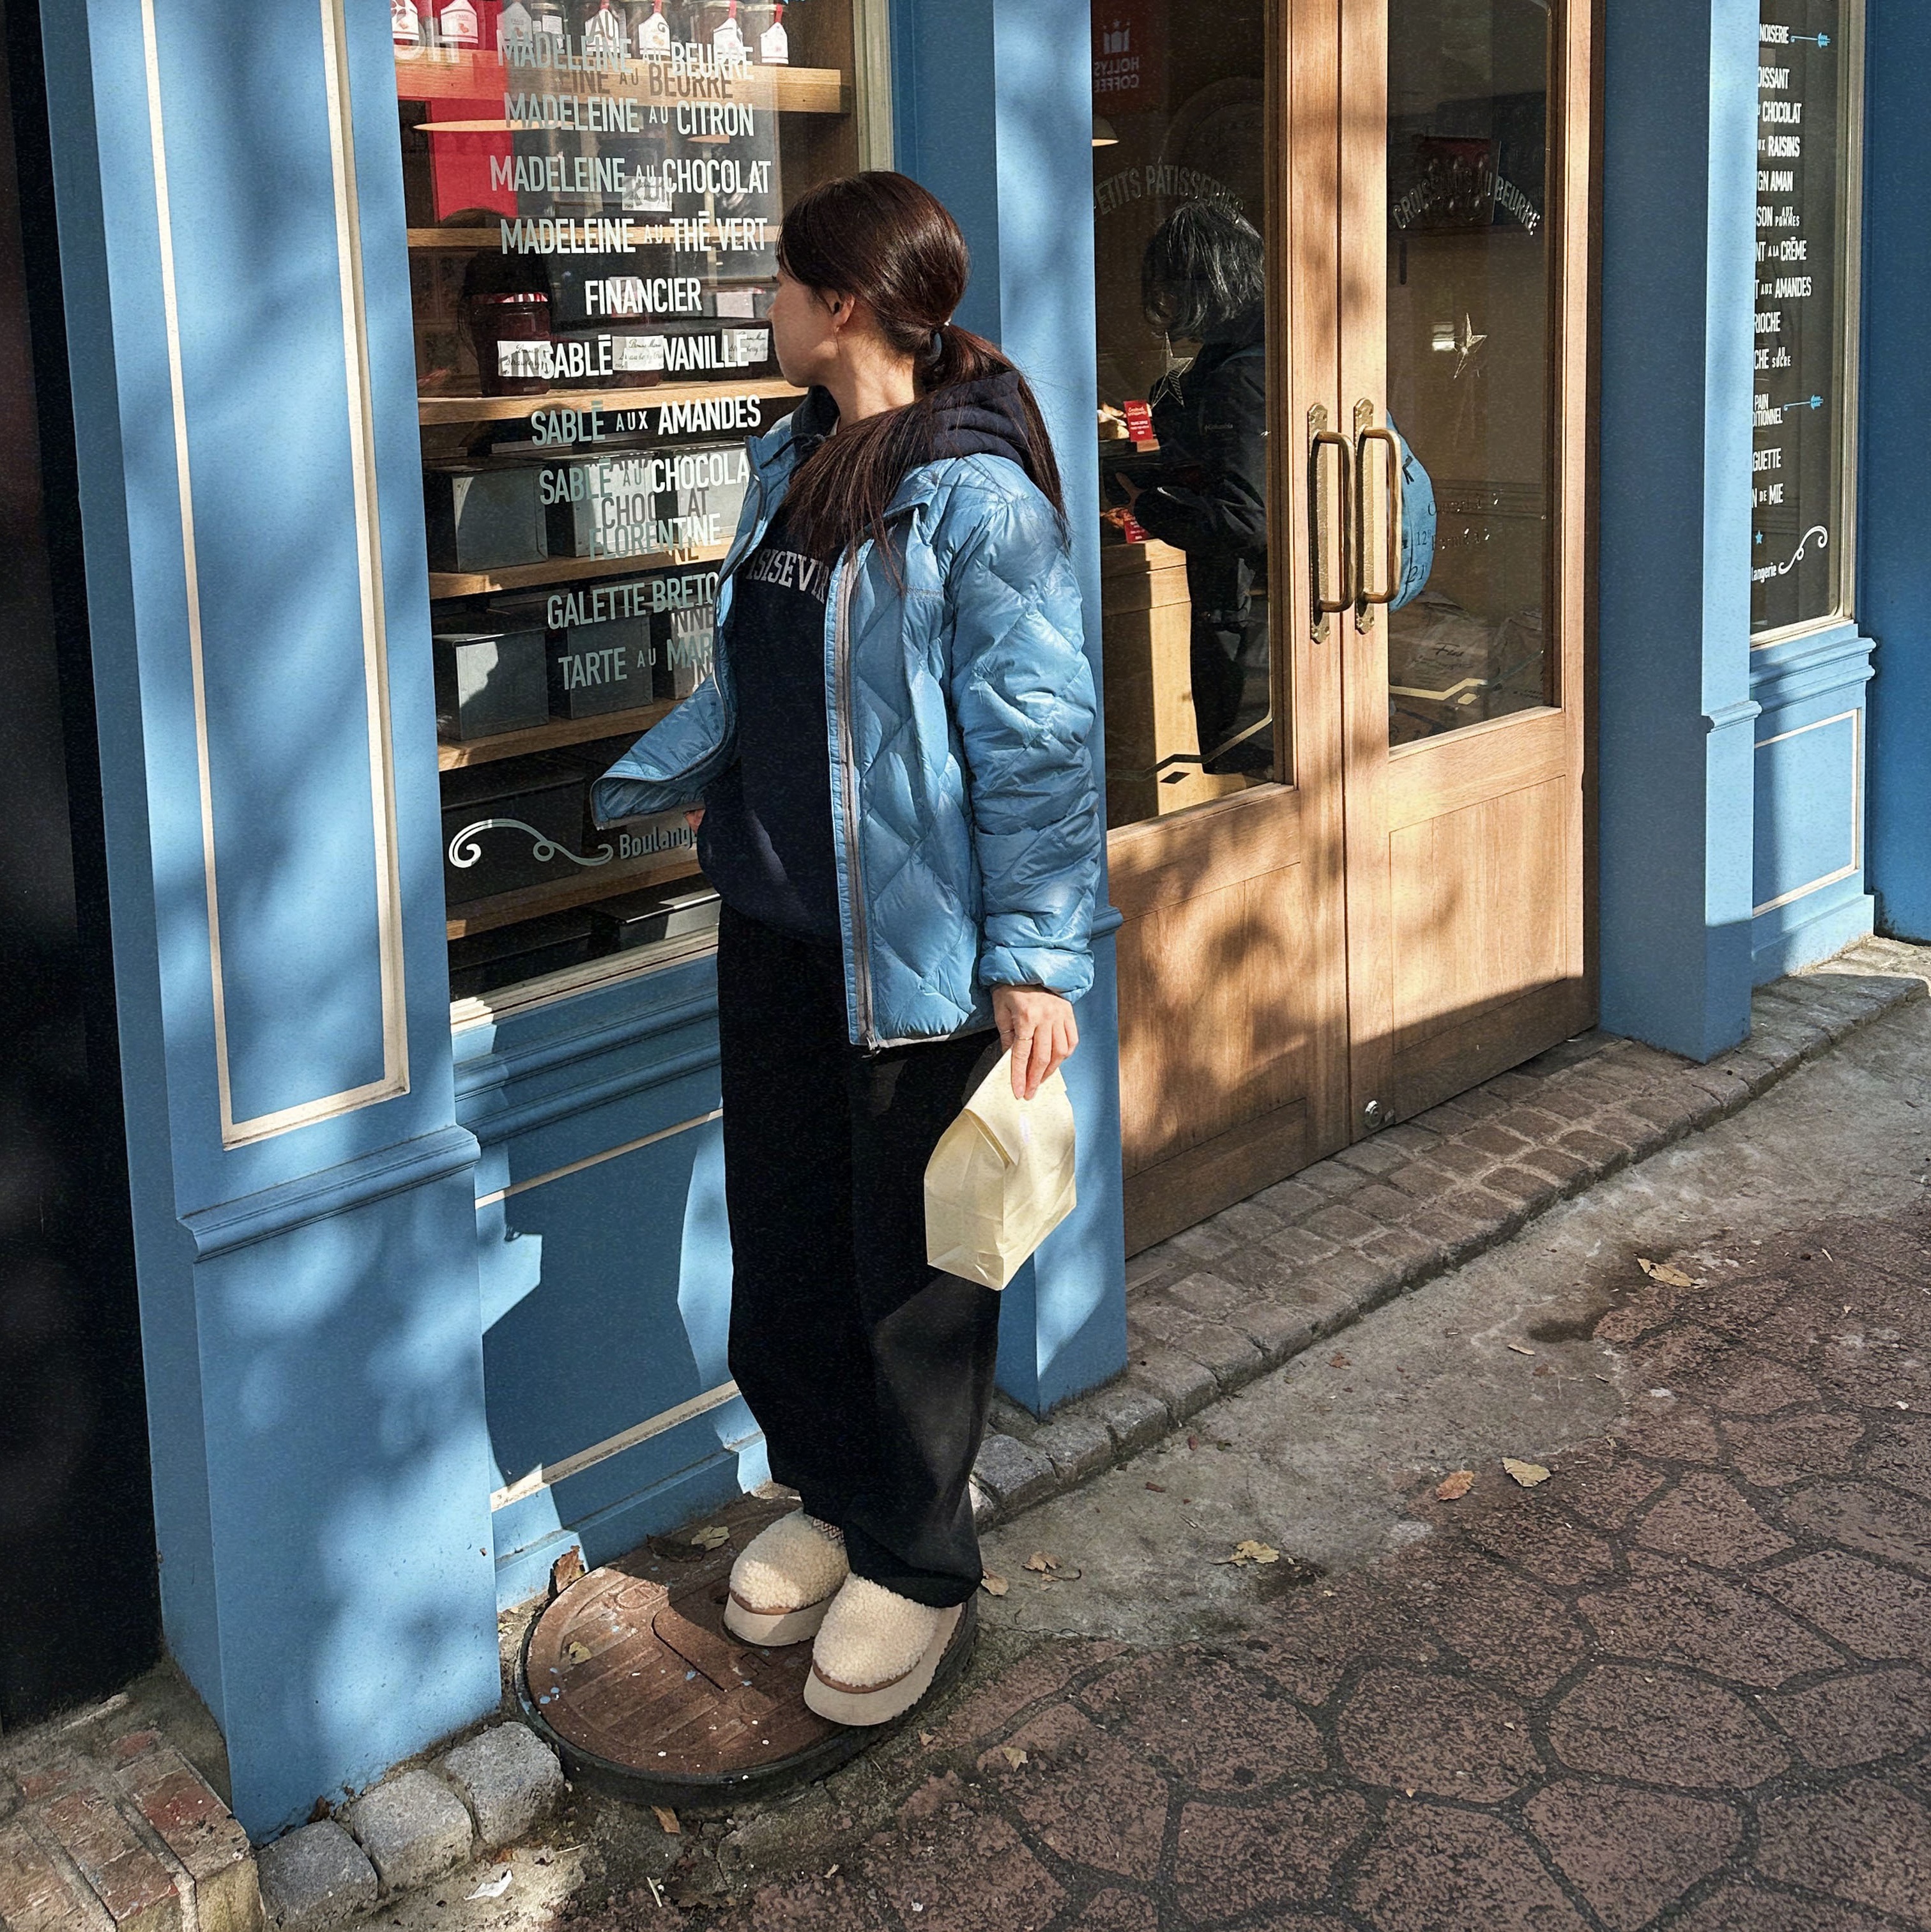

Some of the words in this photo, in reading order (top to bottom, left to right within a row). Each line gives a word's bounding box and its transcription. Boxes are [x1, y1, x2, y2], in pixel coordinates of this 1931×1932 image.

[1759, 24, 1789, 44] NOISERIE
[497, 29, 632, 73] MADELEINE
[643, 47, 662, 64] AU
[671, 42, 754, 80] BEURRE
[504, 93, 639, 133] MADELEINE
[649, 105, 668, 124] AU
[676, 100, 754, 137] CITRON
[1763, 101, 1802, 123] CHOCOLAT
[1768, 135, 1800, 157] RAISINS
[489, 155, 627, 192] MADELEINE
[635, 164, 655, 183] AU
[662, 158, 771, 194] CHOCOLAT
[1757, 170, 1769, 192] GN
[1770, 170, 1794, 192] AMAN
[1757, 206, 1773, 227] SON
[1782, 206, 1794, 217] AUX
[1775, 215, 1800, 227] POMMES
[501, 218, 636, 254] MADELEINE
[645, 224, 663, 244] AU
[716, 217, 768, 251] VERT
[584, 278, 703, 316] FINANCIER
[1760, 283, 1773, 295] AUX
[1775, 276, 1812, 298] AMANDES
[662, 334, 749, 371] VANILLE
[1754, 348, 1769, 370] CHE
[1778, 346, 1786, 357] AU
[1771, 355, 1792, 368] SUCRE
[1754, 394, 1769, 411] PAIN
[616, 410, 648, 433] AUX
[658, 394, 761, 436] AMANDES
[1753, 447, 1782, 472] GUETTE
[623, 466, 643, 487] AU
[1759, 489, 1767, 503] DE
[1768, 483, 1784, 505] MIE
[589, 513, 721, 562] FLORENTINE
[547, 582, 645, 630] GALETTE
[558, 647, 627, 690] TARTE
[637, 648, 656, 668] AU
